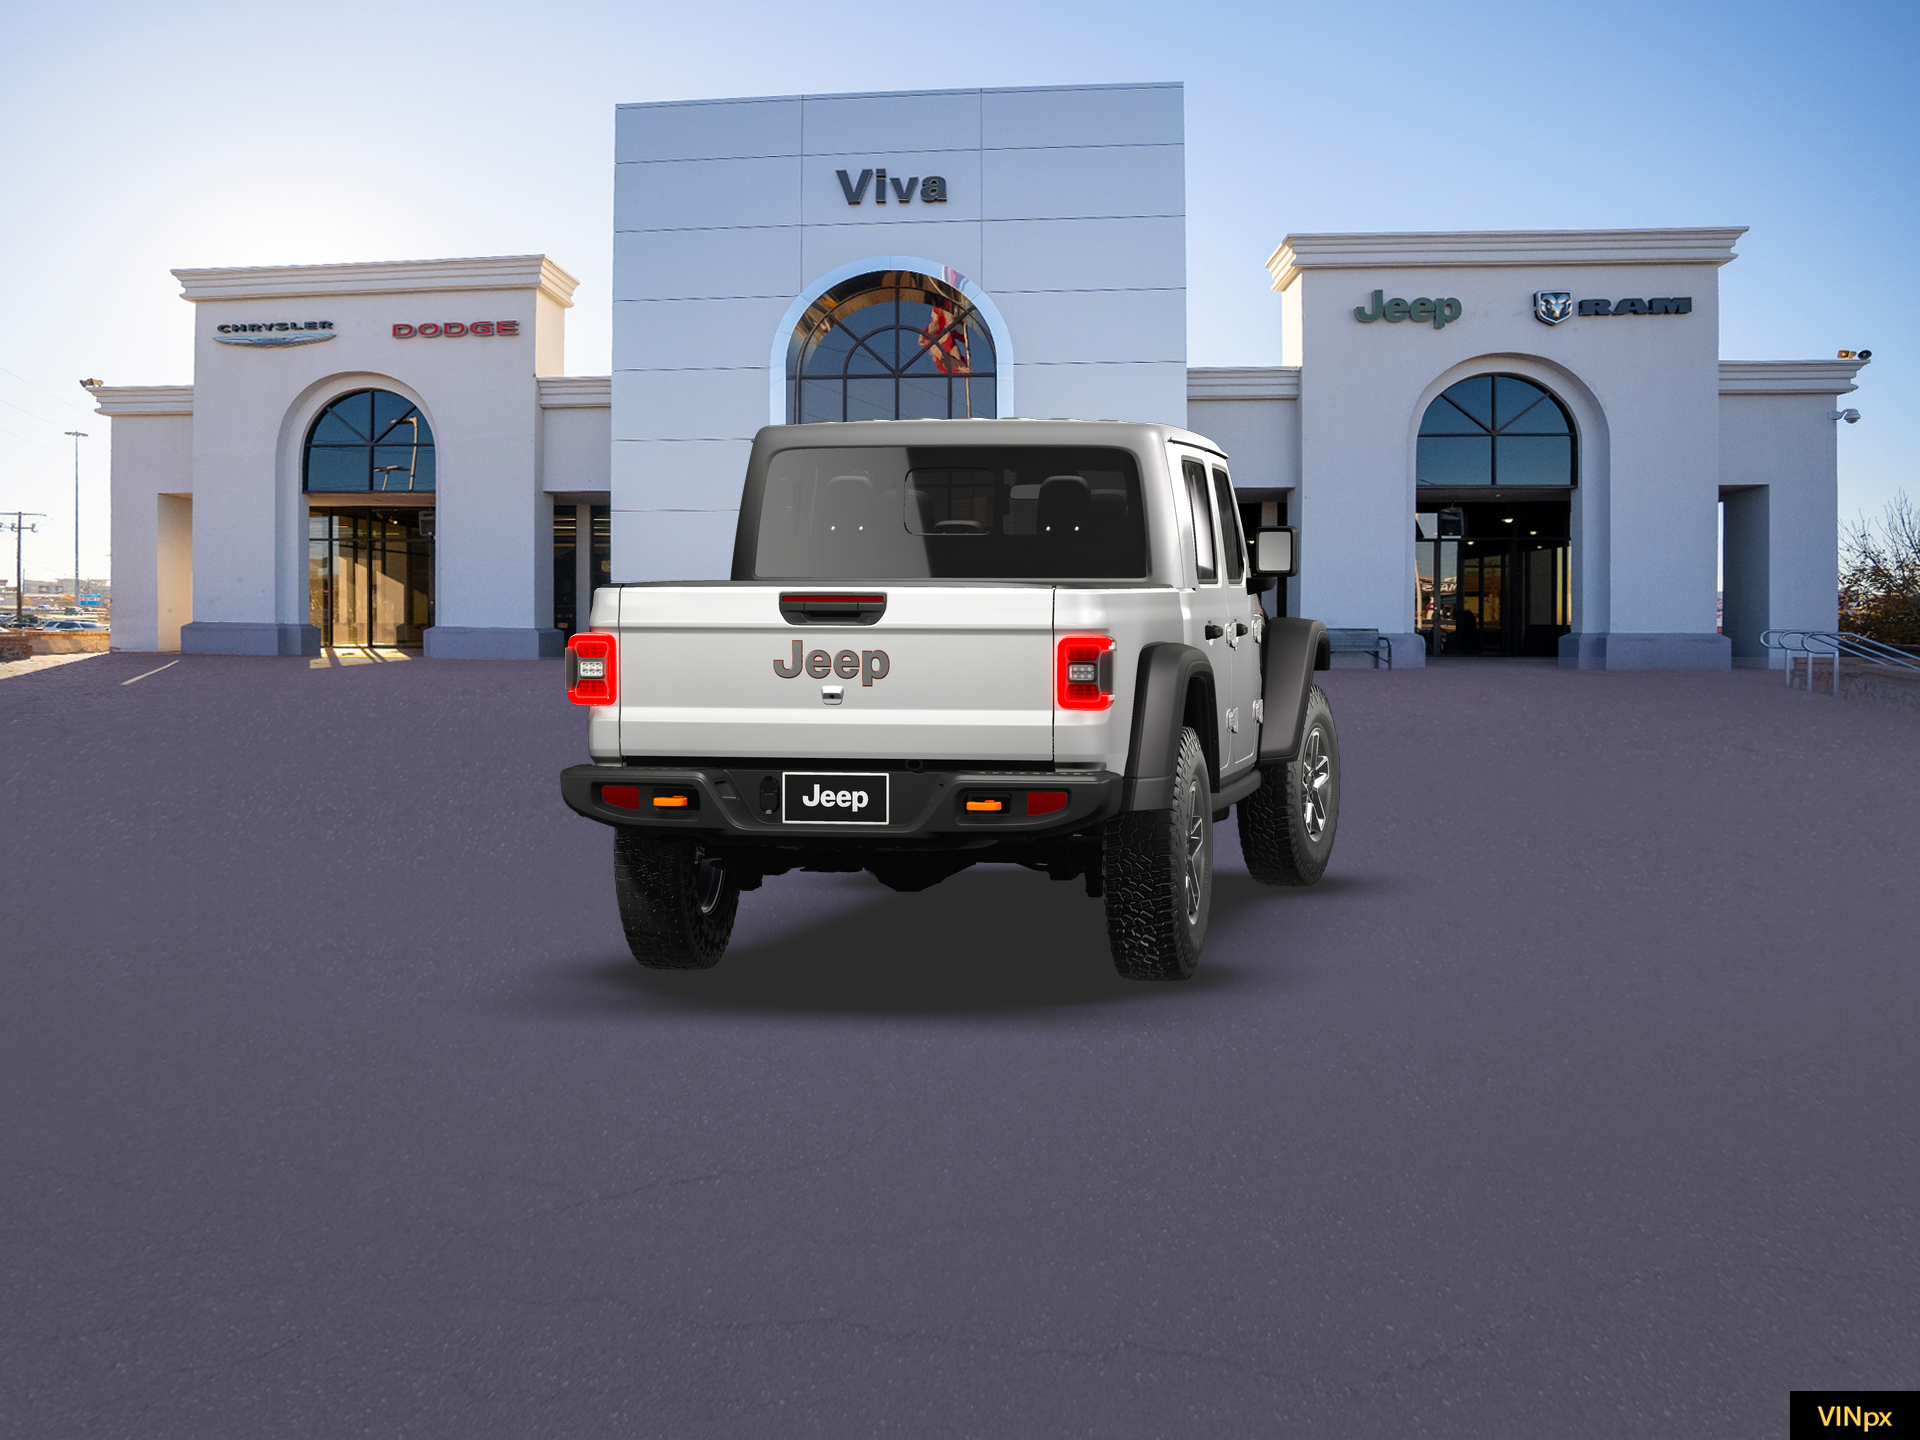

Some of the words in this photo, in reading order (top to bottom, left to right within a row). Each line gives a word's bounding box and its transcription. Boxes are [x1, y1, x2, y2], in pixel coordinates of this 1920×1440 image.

[835, 168, 948, 206] Viva
[1354, 289, 1463, 329] Jeep
[1578, 296, 1692, 316] RAM
[217, 320, 334, 334] CHRYSLER
[392, 319, 520, 339] DODGE
[773, 639, 890, 687] Jeep
[802, 783, 869, 813] Jeep
